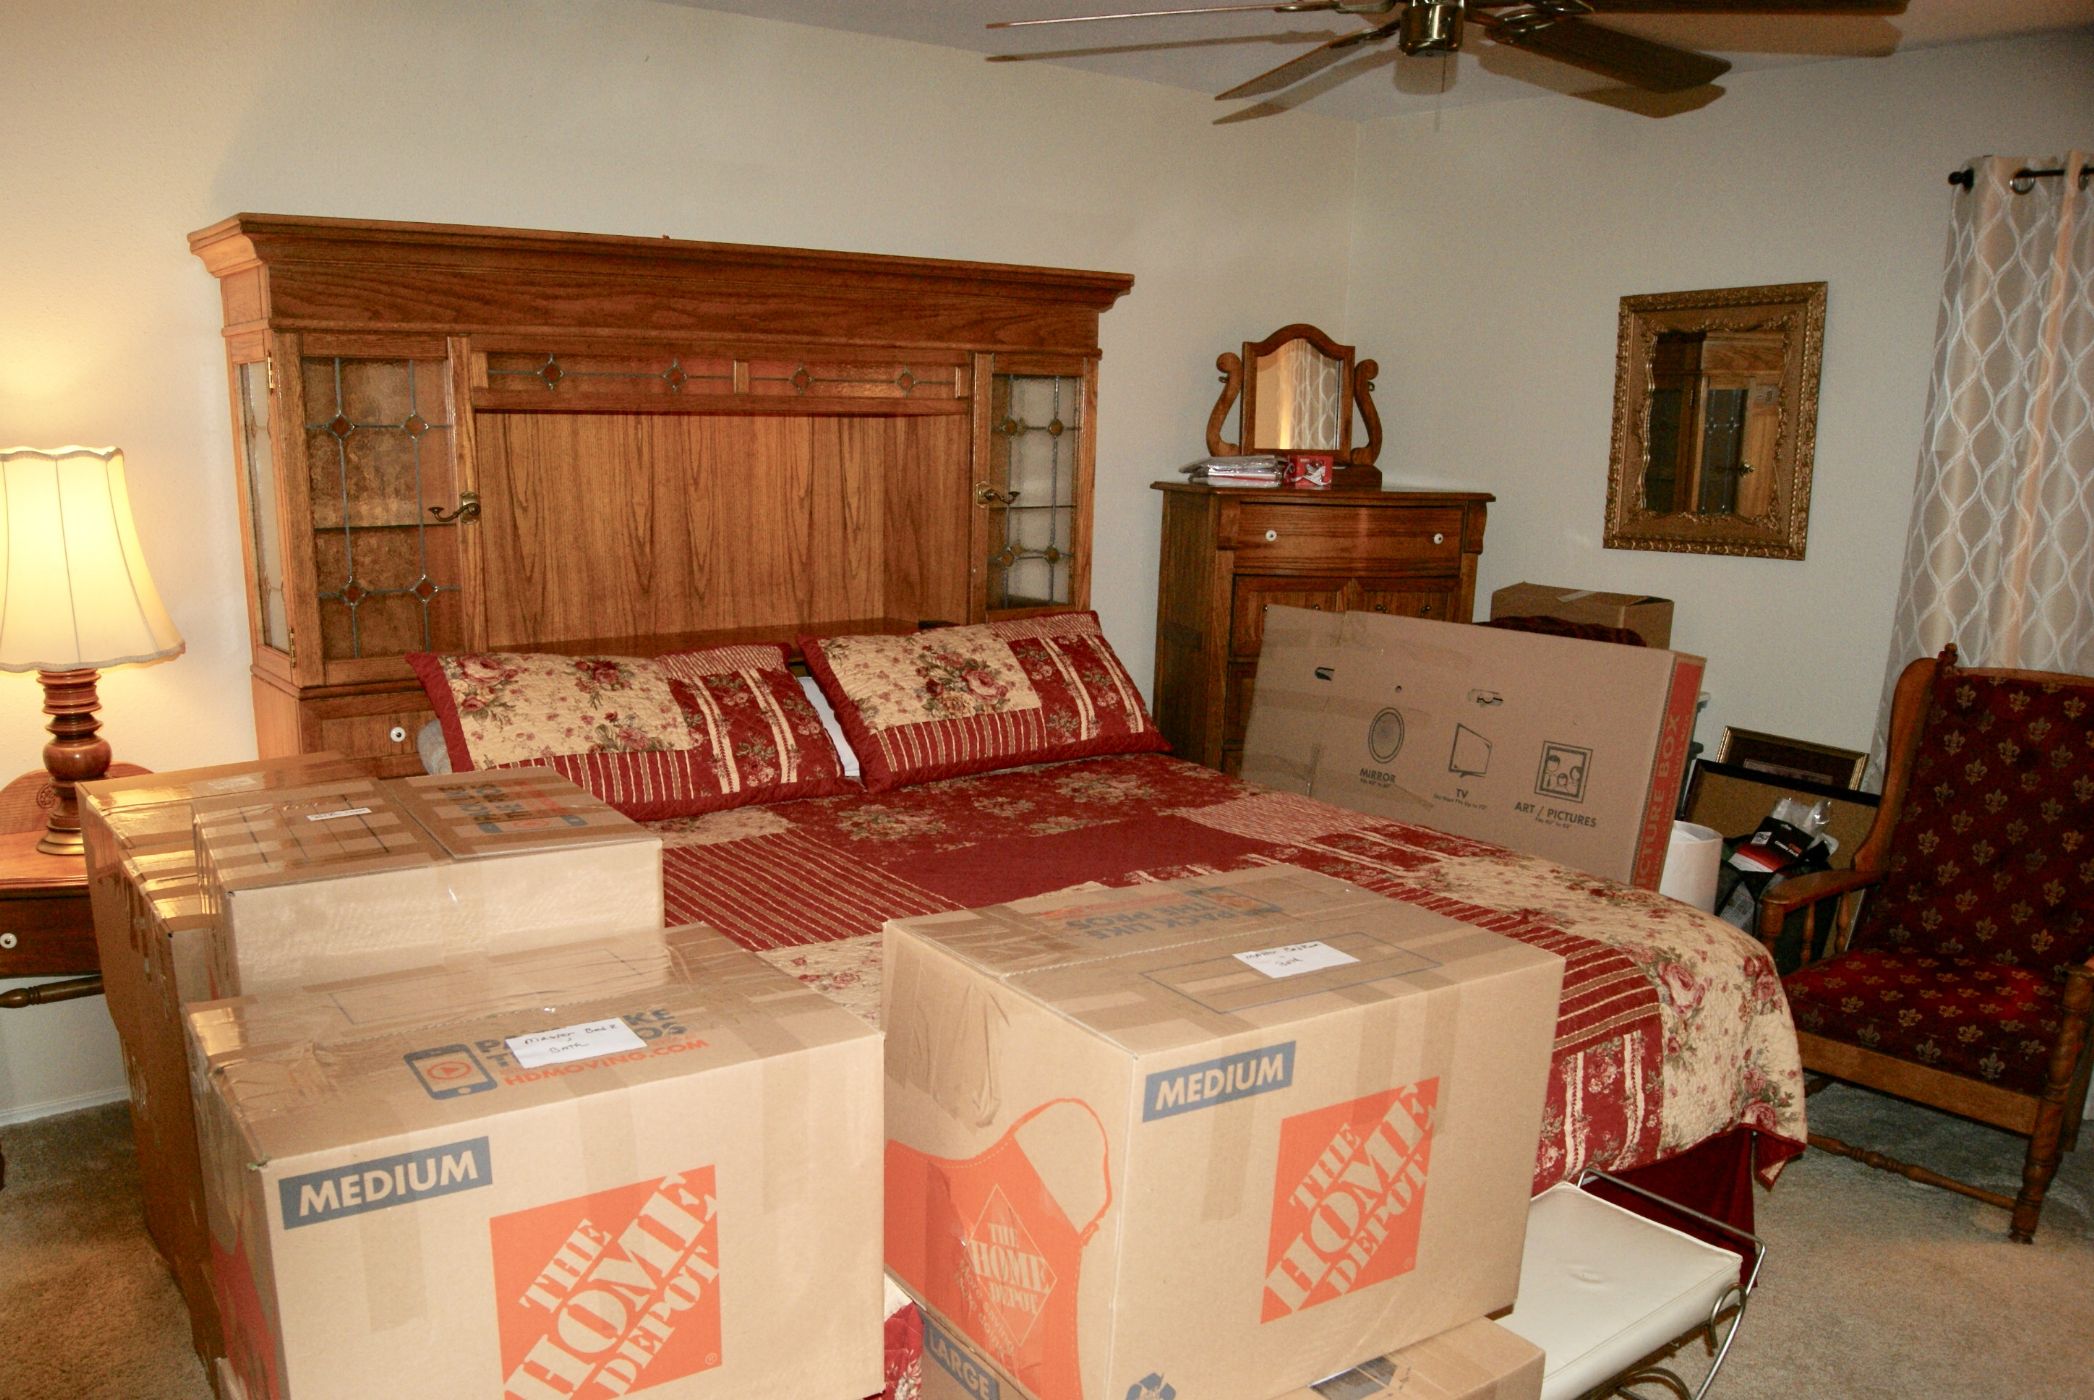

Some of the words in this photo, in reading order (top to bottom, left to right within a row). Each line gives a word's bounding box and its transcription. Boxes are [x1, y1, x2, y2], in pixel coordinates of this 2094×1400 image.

[1360, 767, 1396, 784] MIRROR
[1456, 787, 1469, 799] TV
[1636, 788, 1665, 886] ICTURE
[1658, 713, 1681, 778] BOX
[1514, 802, 1535, 814] ART
[1547, 808, 1597, 828] PICTURES
[622, 1008, 675, 1026] KE
[638, 1024, 687, 1041] OS
[503, 1039, 711, 1087] HDMOVING.COM
[1155, 1053, 1284, 1111] MEDIUM
[300, 1150, 479, 1217] MEDIUM
[1289, 1122, 1361, 1212] THE
[1266, 1083, 1437, 1312] HOME
[1327, 1153, 1427, 1295] DEPOT
[987, 1222, 1018, 1248] THE
[503, 1173, 717, 1400] HOME
[518, 1218, 613, 1313] THE
[970, 1239, 1051, 1295] HOME
[593, 1245, 719, 1397] DEPOT
[988, 1279, 1040, 1315] DEPOT
[929, 1328, 990, 1400] LARGE
